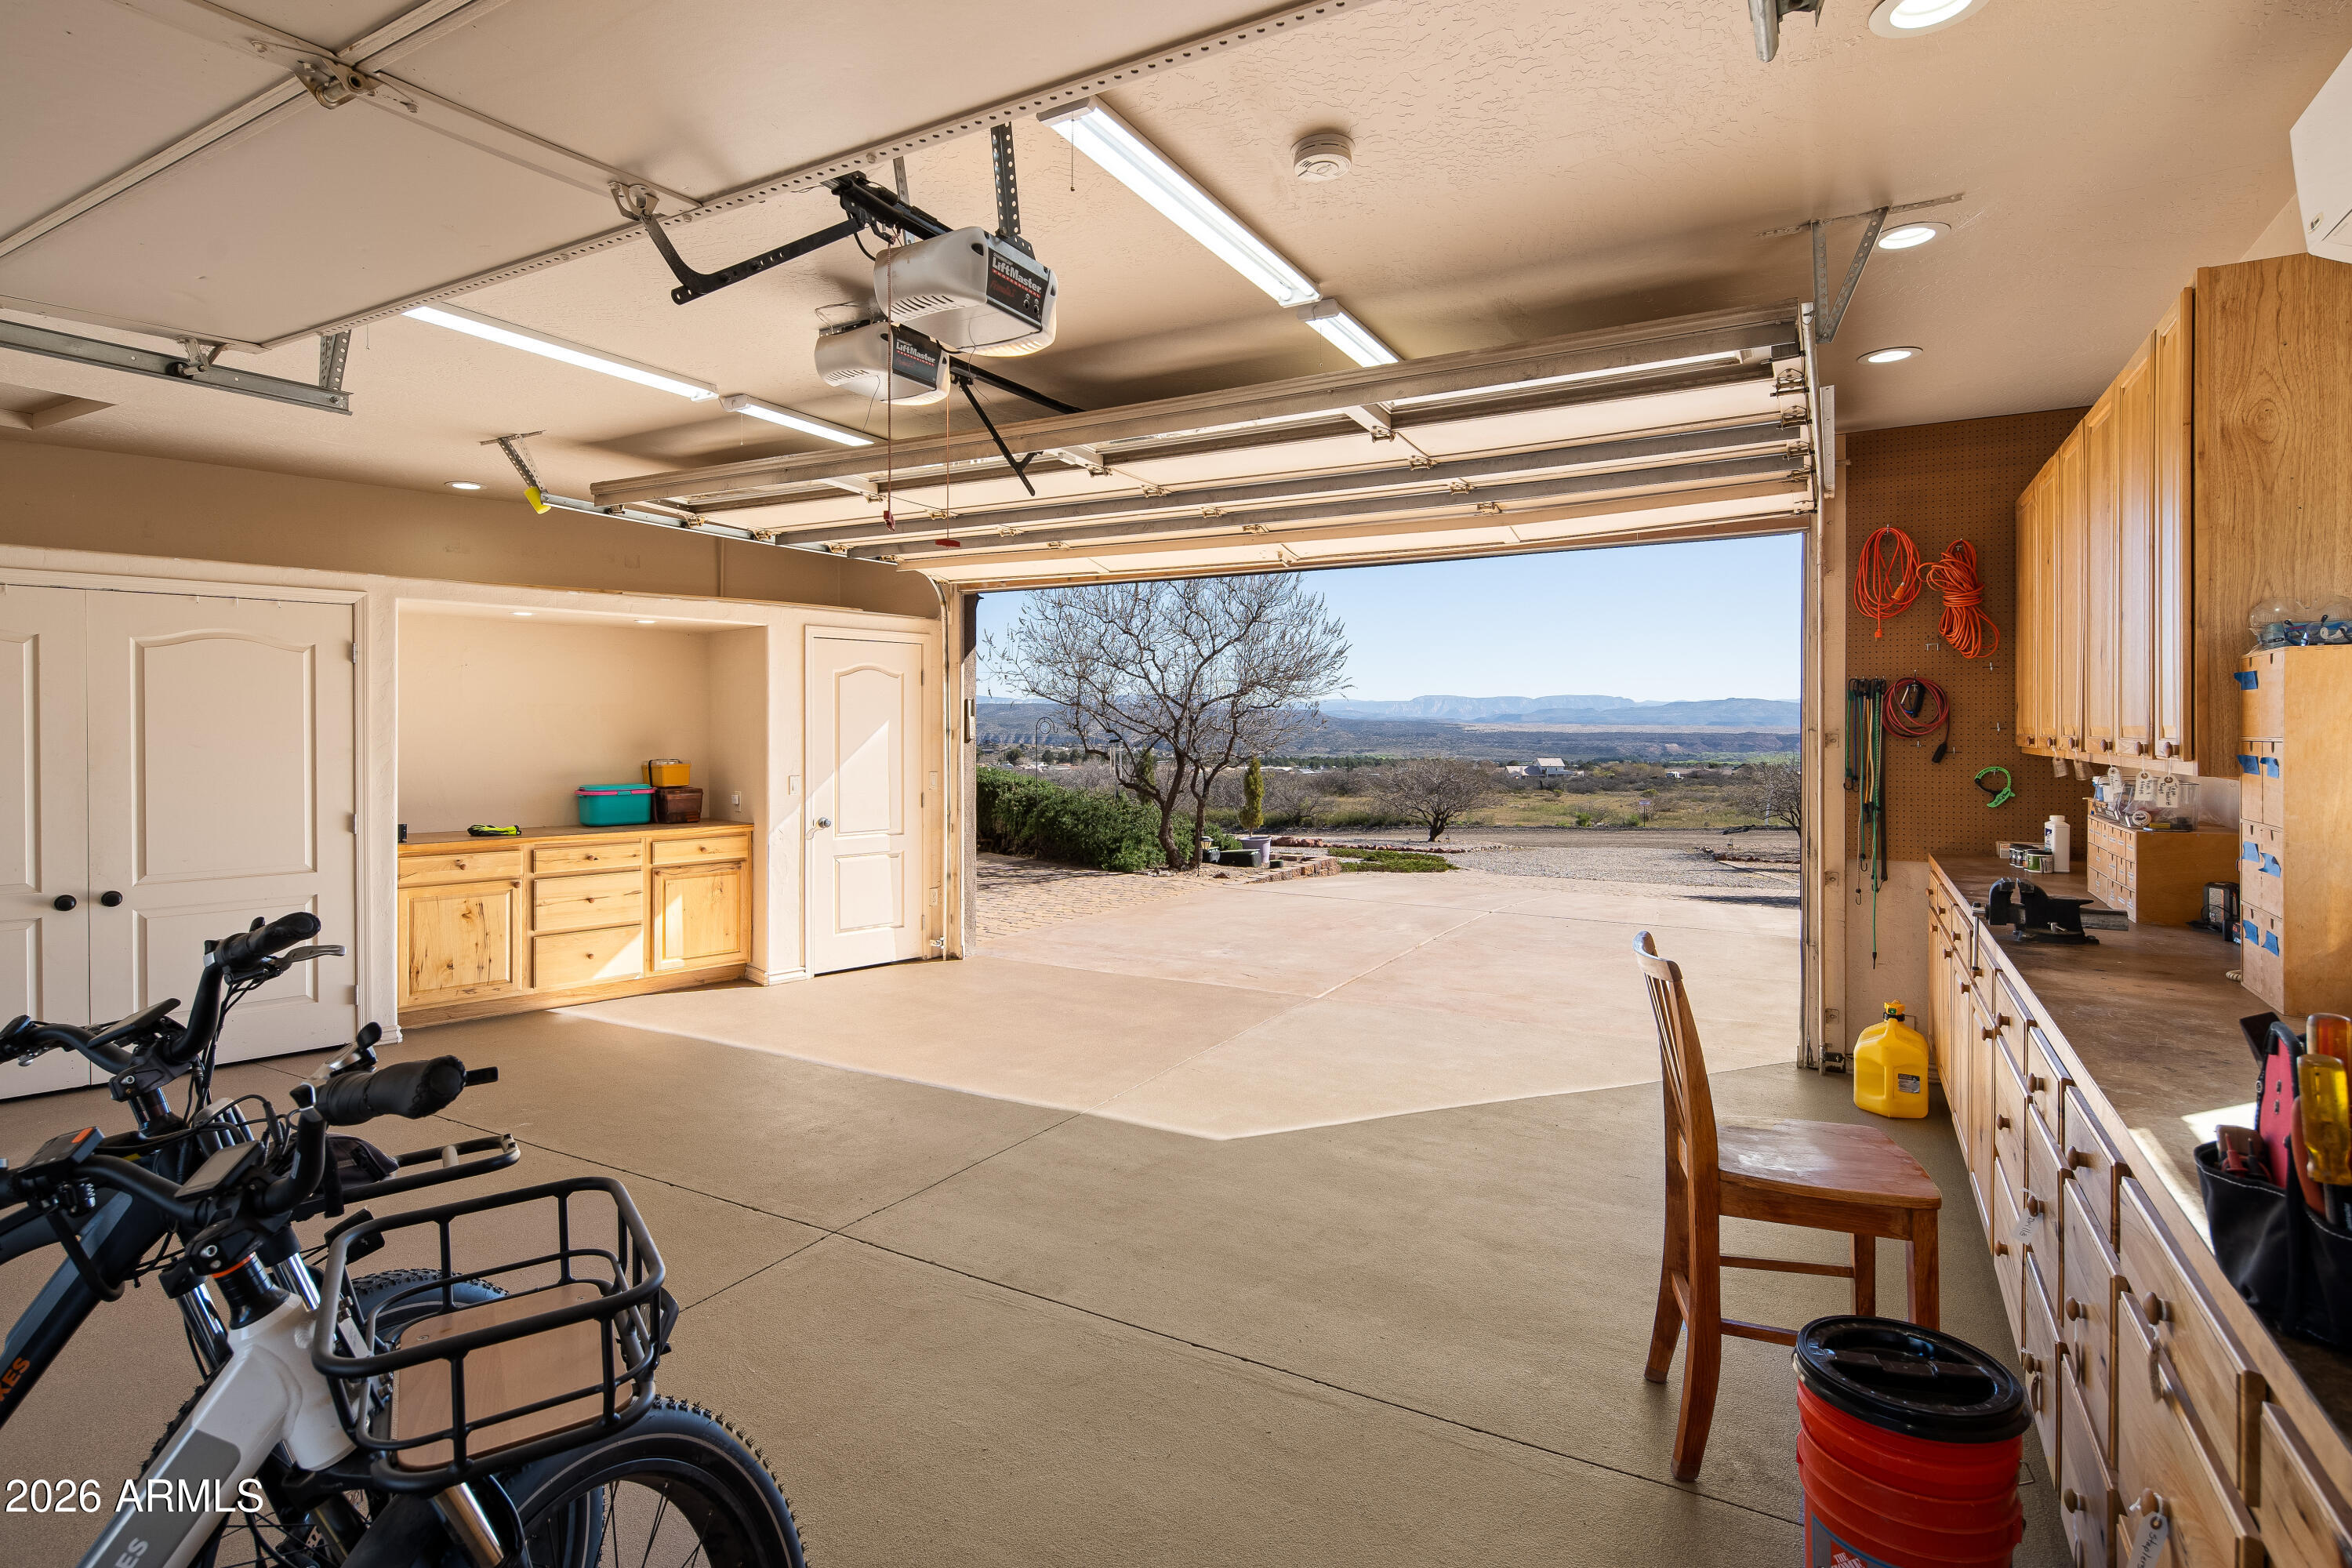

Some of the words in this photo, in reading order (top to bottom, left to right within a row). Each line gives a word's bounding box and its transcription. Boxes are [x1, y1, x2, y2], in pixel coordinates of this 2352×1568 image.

[993, 256, 1042, 293] LiftMaster
[896, 341, 935, 363] LiftMaster
[1833, 1552, 1849, 1563] THE
